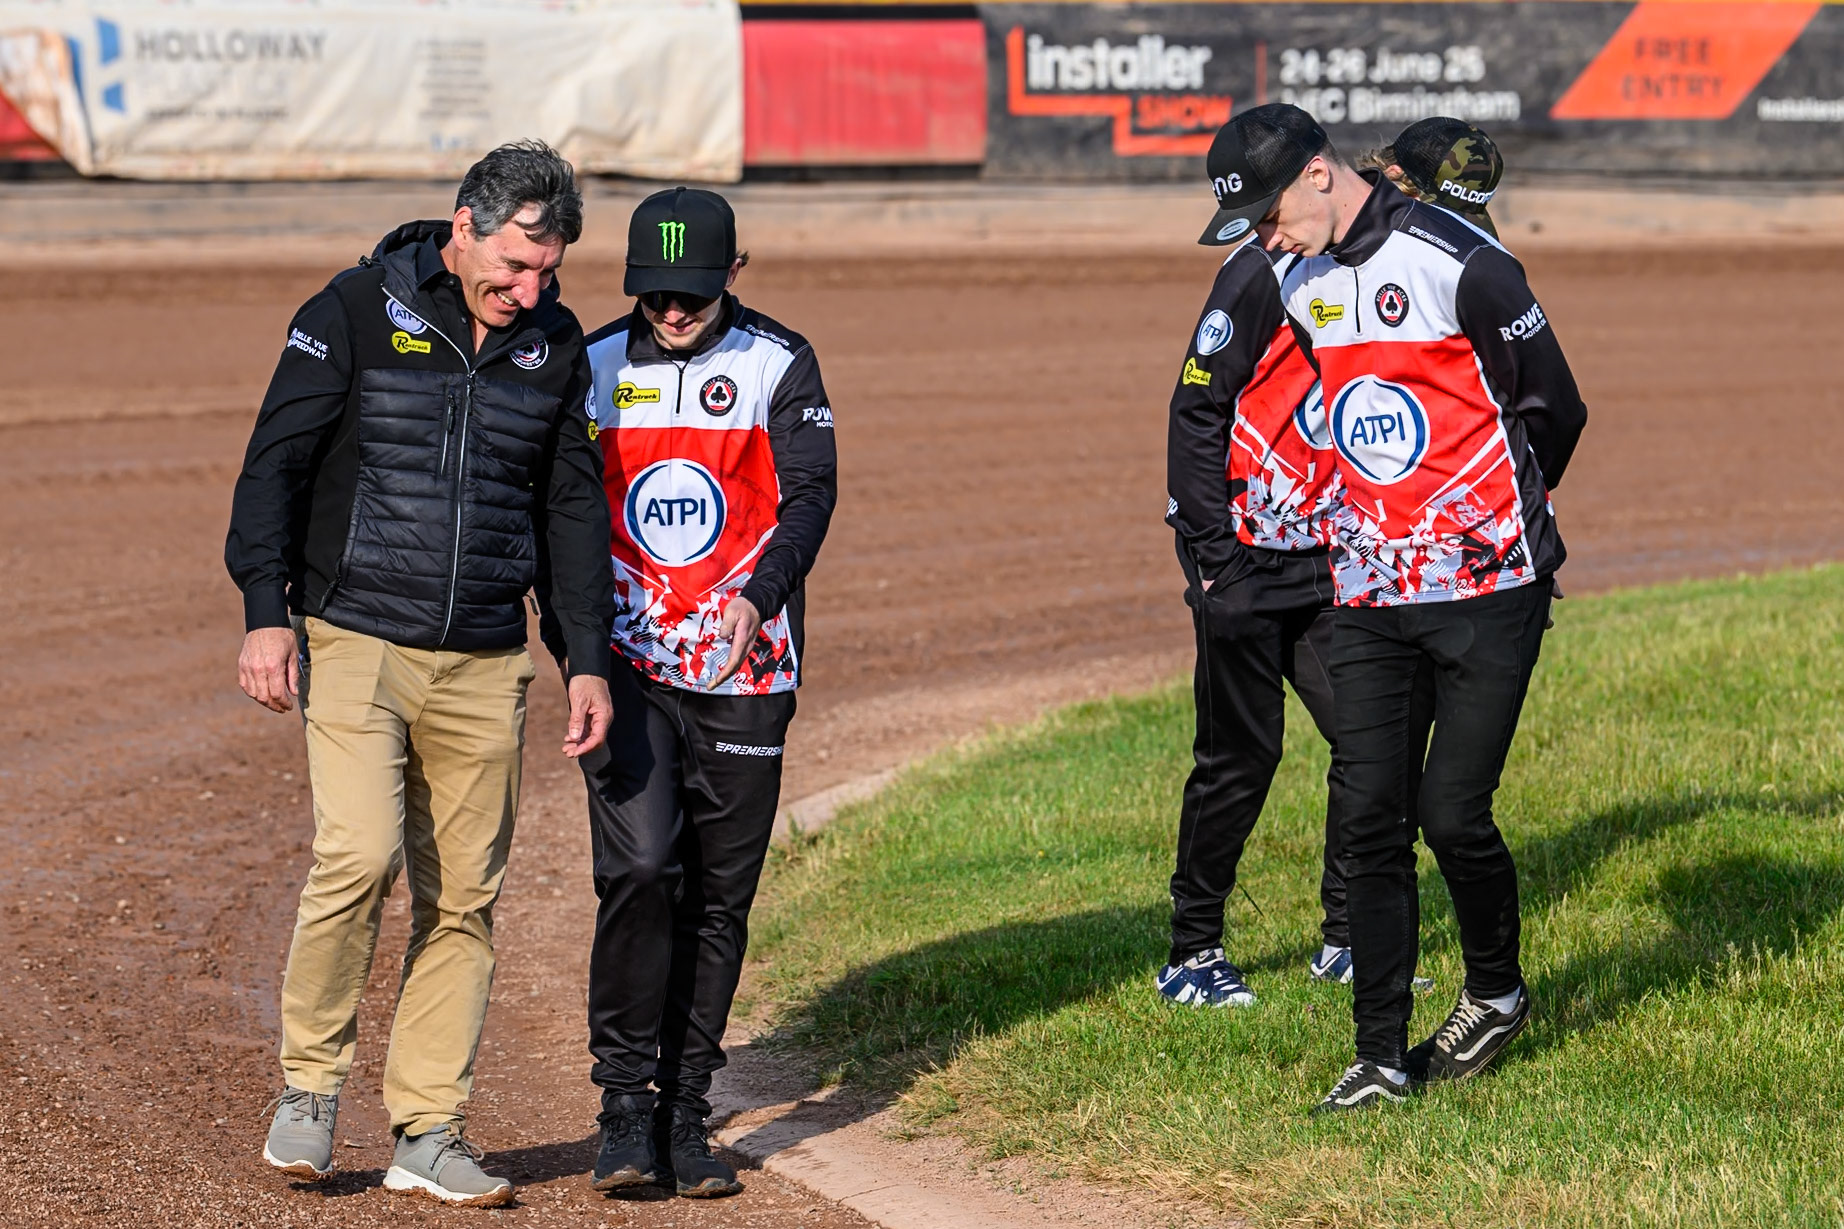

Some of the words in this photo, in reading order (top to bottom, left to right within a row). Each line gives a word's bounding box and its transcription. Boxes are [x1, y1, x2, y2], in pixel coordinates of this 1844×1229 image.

[134, 29, 328, 62] HOLLOWAY
[1027, 34, 1212, 90] installer
[1634, 37, 1711, 64] FREE
[1368, 46, 1442, 84] June
[1349, 85, 1521, 124] Birmingham
[1622, 74, 1725, 101] ENTRY
[1498, 303, 1543, 341] ROWE
[314, 340, 328, 352] VUE
[1351, 411, 1406, 447] ATPI
[643, 498, 706, 526] ATPI
